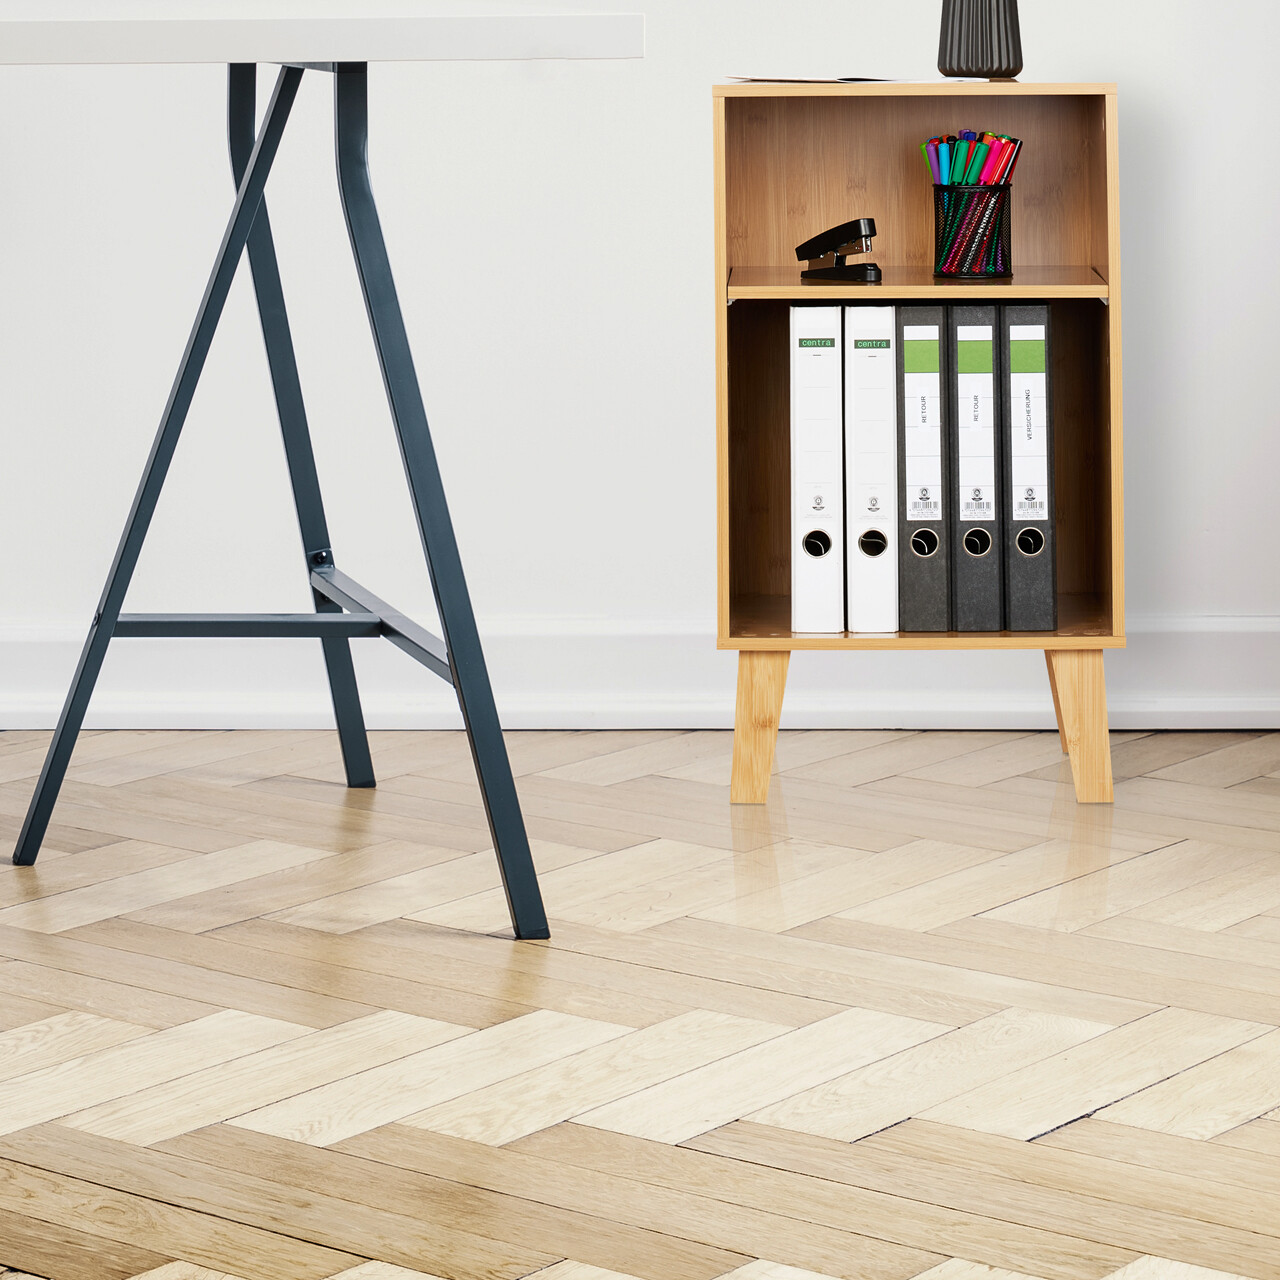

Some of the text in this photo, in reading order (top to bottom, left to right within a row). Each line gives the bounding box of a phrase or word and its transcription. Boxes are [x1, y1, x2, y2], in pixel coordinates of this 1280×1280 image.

[802, 339, 831, 347] centra
[857, 340, 887, 348] centra
[1024, 389, 1032, 440] VERSICHERUNG
